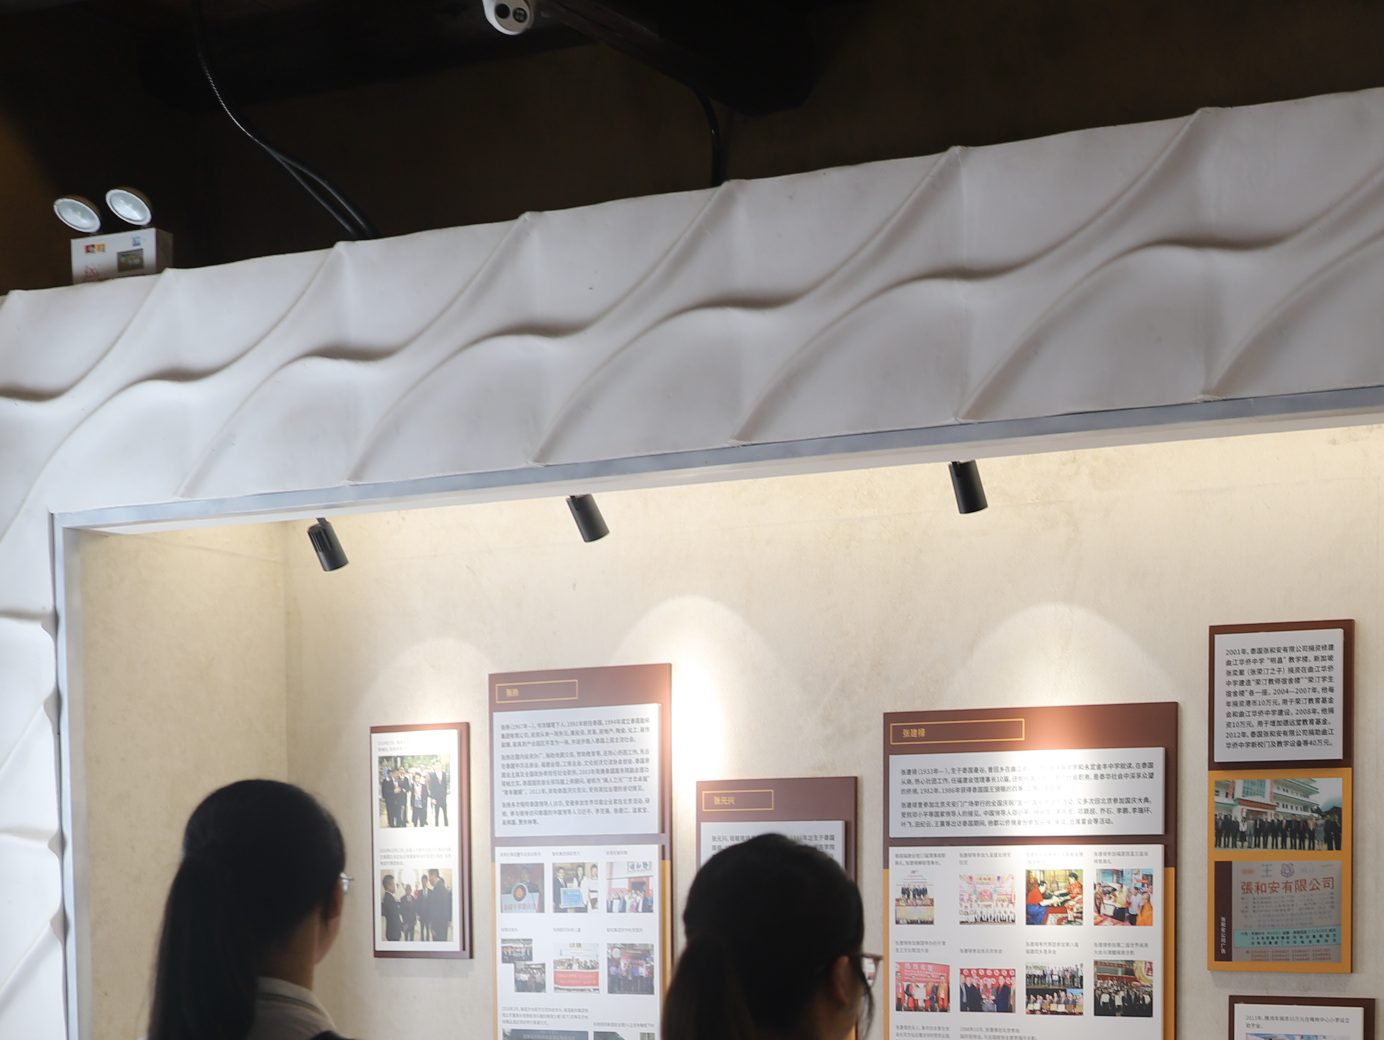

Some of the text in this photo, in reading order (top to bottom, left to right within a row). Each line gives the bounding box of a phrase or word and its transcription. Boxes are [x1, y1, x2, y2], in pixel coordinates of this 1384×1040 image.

[1241, 877, 1335, 895] 張和安有限公司
